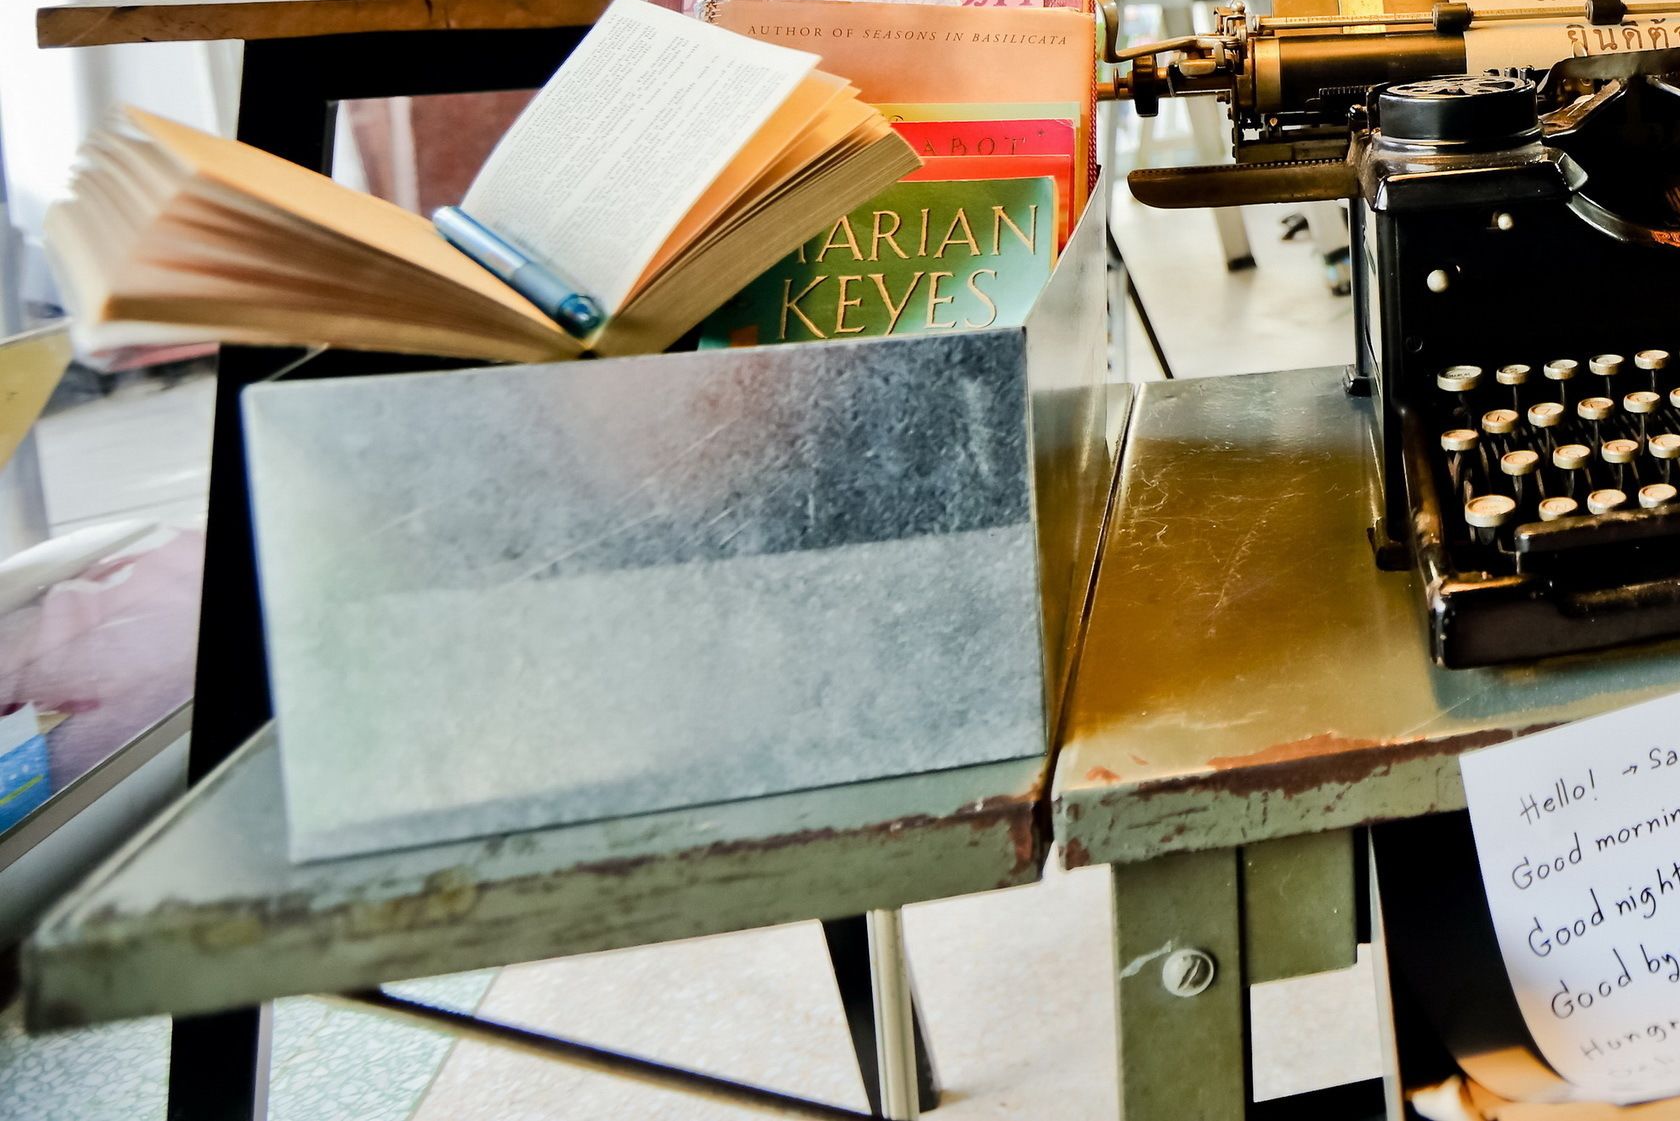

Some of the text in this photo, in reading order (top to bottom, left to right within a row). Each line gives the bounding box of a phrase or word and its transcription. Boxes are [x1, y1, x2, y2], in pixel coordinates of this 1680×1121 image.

[747, 24, 1069, 46] AUTHOR OF SEASONS IN BASILICATA
[798, 205, 1038, 264] ARIAN
[778, 269, 998, 339] KEYES
[1519, 769, 1599, 826] Hello!
[1511, 831, 1583, 890] Good
[1528, 888, 1604, 958] Good
[1550, 947, 1633, 1020] Good
